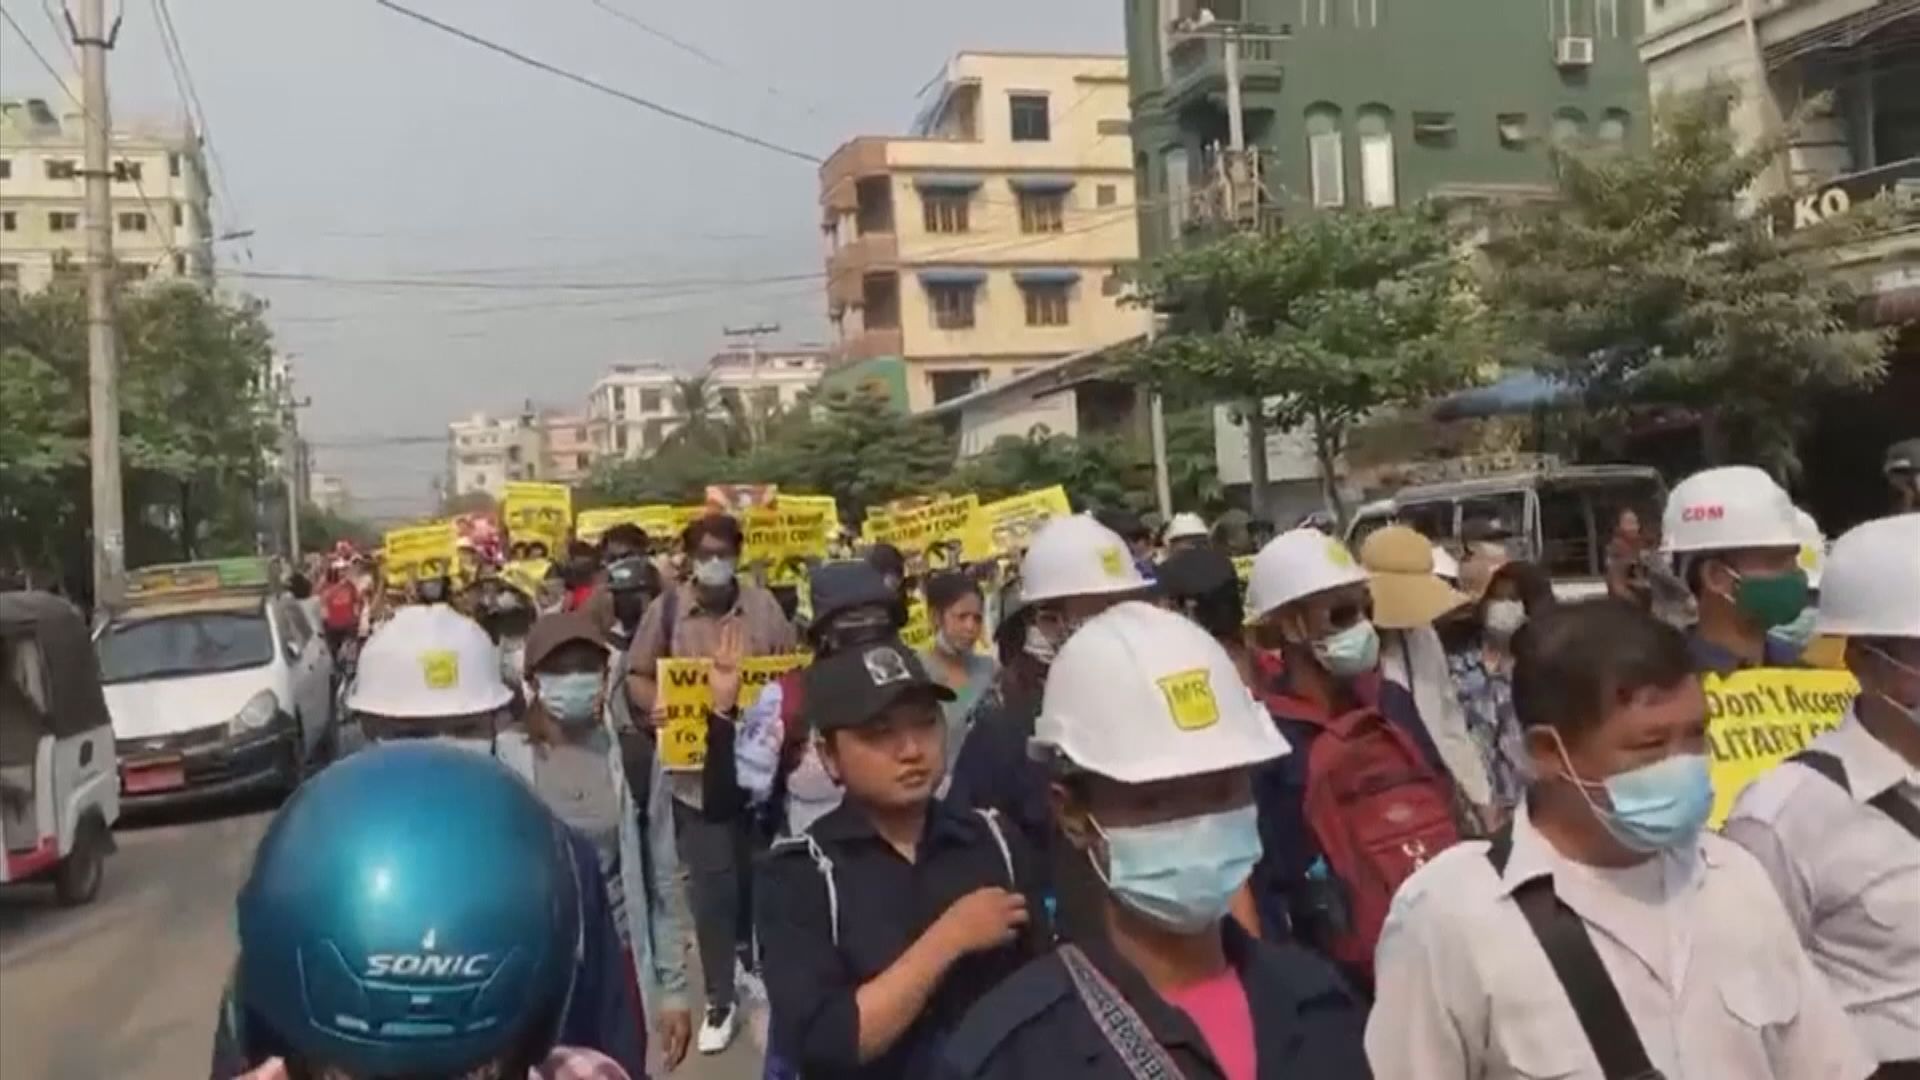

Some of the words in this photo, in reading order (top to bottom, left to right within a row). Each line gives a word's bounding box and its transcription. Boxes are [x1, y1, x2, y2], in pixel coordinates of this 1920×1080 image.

[1682, 505, 1725, 523] CDM
[1704, 684, 1785, 719] Don't
[364, 953, 489, 978] SONIC
